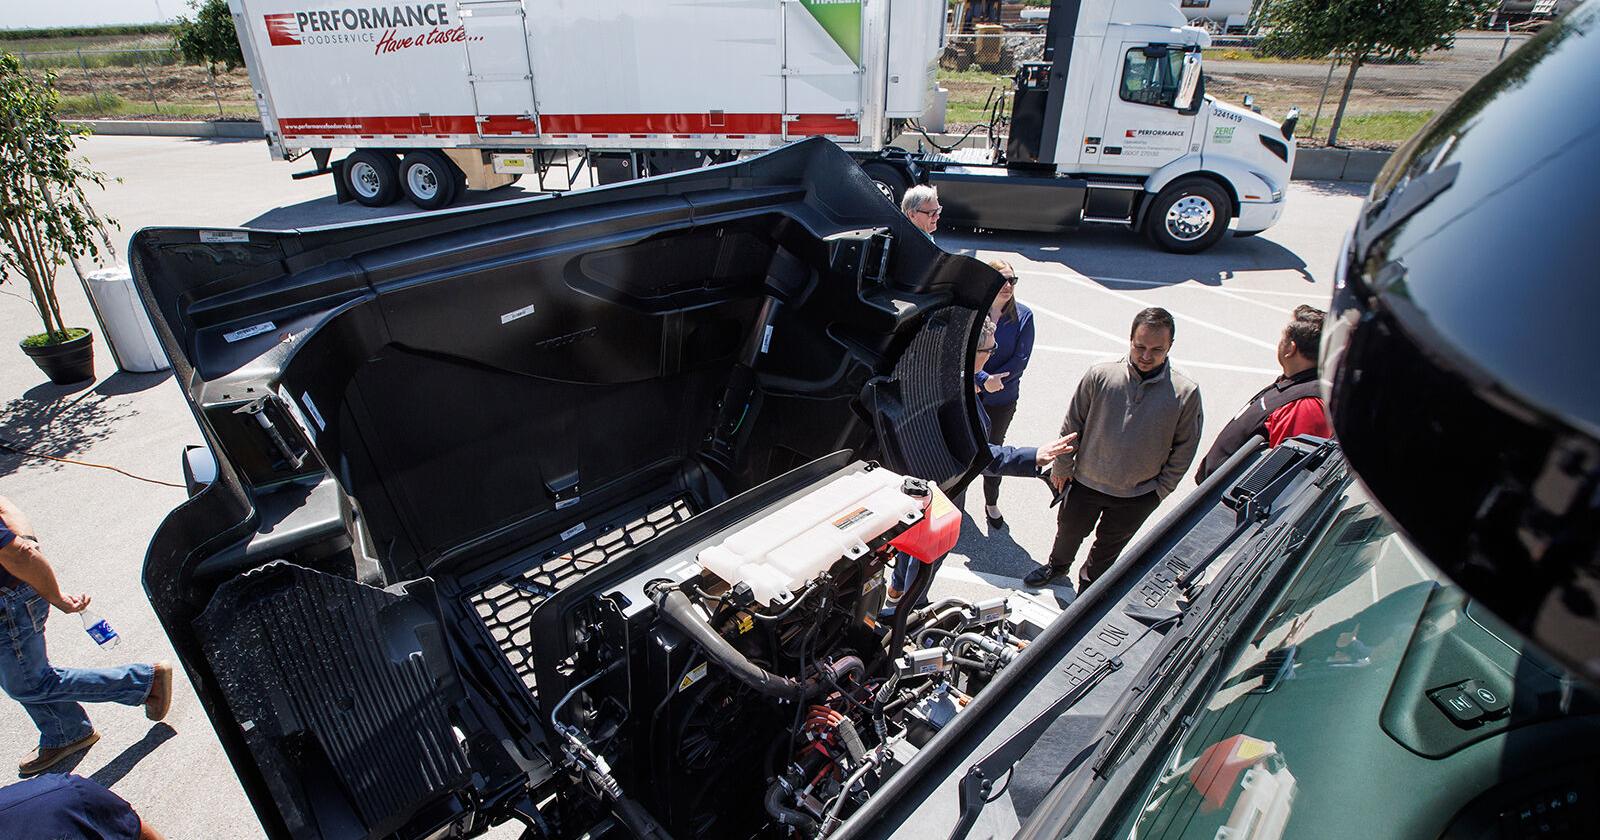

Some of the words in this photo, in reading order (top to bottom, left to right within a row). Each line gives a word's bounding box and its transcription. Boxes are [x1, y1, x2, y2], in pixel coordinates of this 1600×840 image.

[295, 4, 449, 32] PERFORMANCE
[302, 33, 375, 45] FOODSERVICE
[375, 30, 414, 55] Have
[416, 36, 425, 46] a
[1213, 109, 1242, 122] 3241419
[1137, 129, 1184, 137] PERFORMANCE
[1215, 126, 1235, 135] ZERO
[1165, 555, 1191, 576] NO
[1139, 573, 1174, 608] STEP
[1096, 623, 1129, 647] NO
[1063, 647, 1107, 687] STEP
